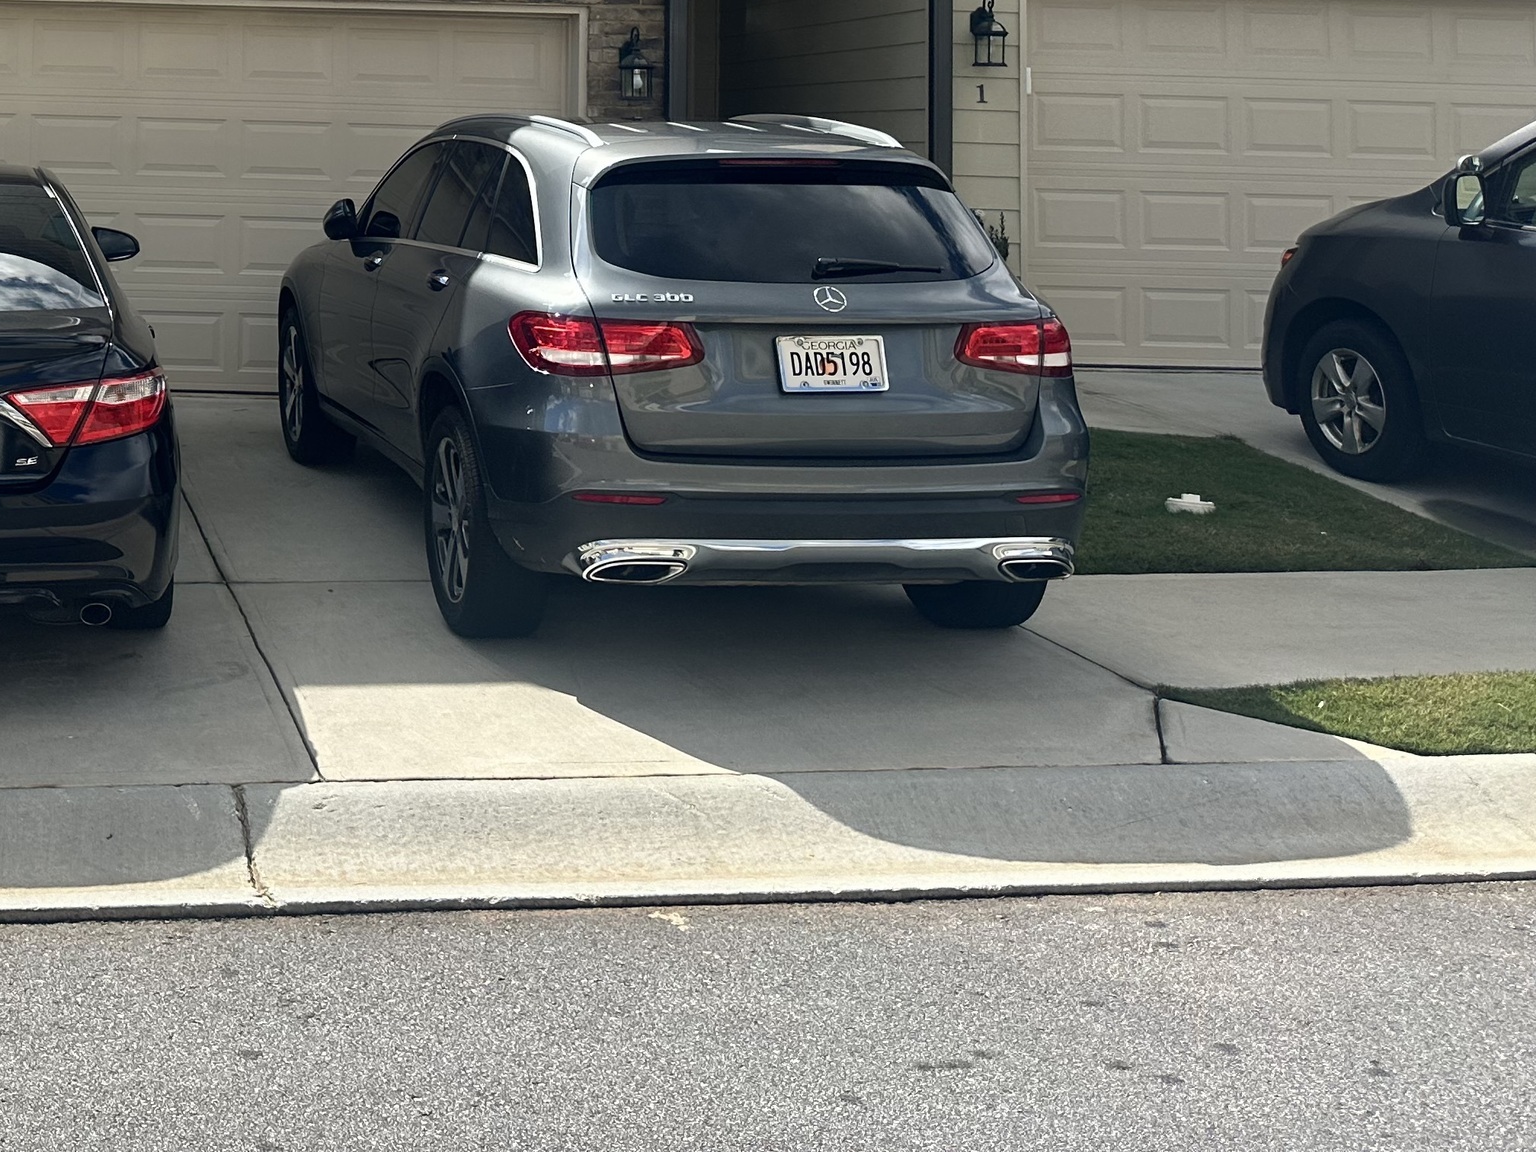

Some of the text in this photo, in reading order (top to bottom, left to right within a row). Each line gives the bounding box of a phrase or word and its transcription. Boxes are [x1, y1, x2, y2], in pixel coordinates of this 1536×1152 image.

[976, 84, 988, 103] 1
[611, 291, 694, 303] GLC 300
[800, 340, 857, 351] GEORGIA
[789, 351, 873, 377] DAD5198
[15, 455, 39, 466] SE
